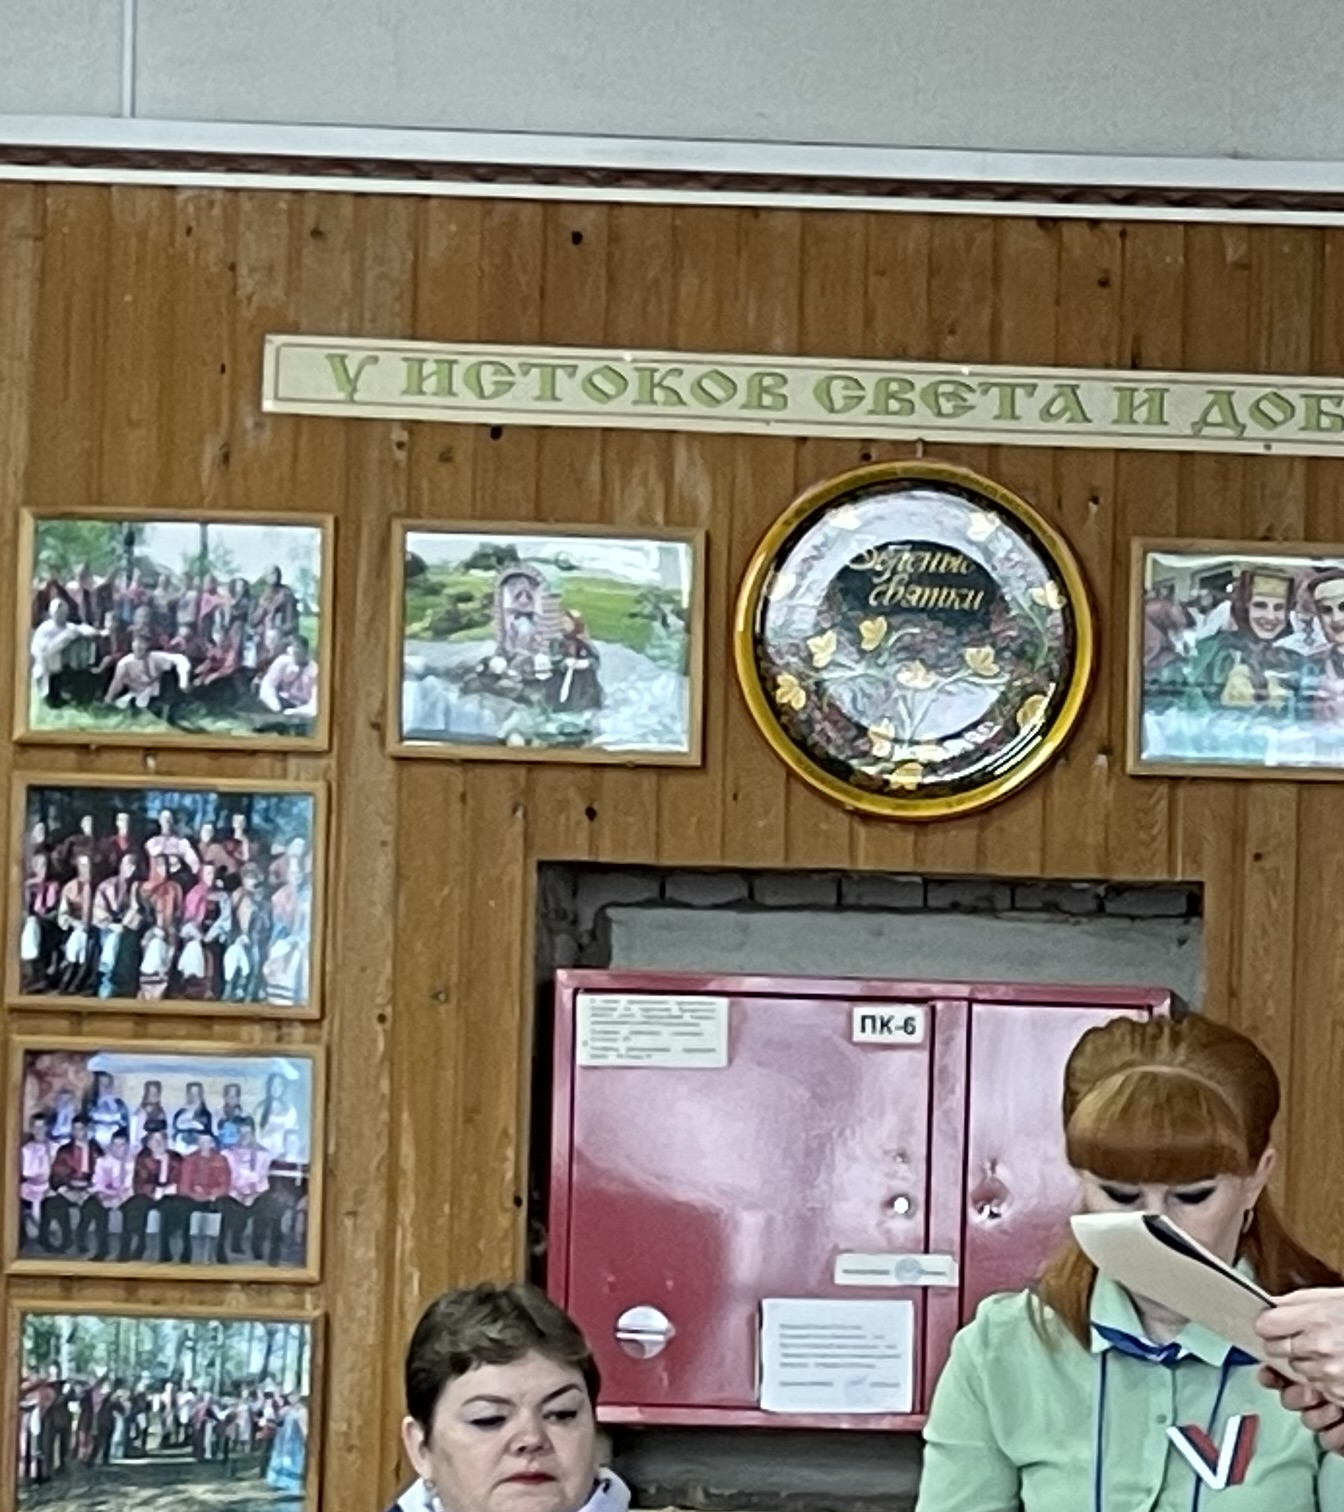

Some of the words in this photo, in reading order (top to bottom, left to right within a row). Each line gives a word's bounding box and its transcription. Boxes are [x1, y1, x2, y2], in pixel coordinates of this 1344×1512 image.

[400, 357, 789, 411] ИСТОКОВ
[812, 375, 1092, 424] СВЕТА
[1111, 385, 1170, 426] И
[860, 1014, 917, 1037] ПК-6
